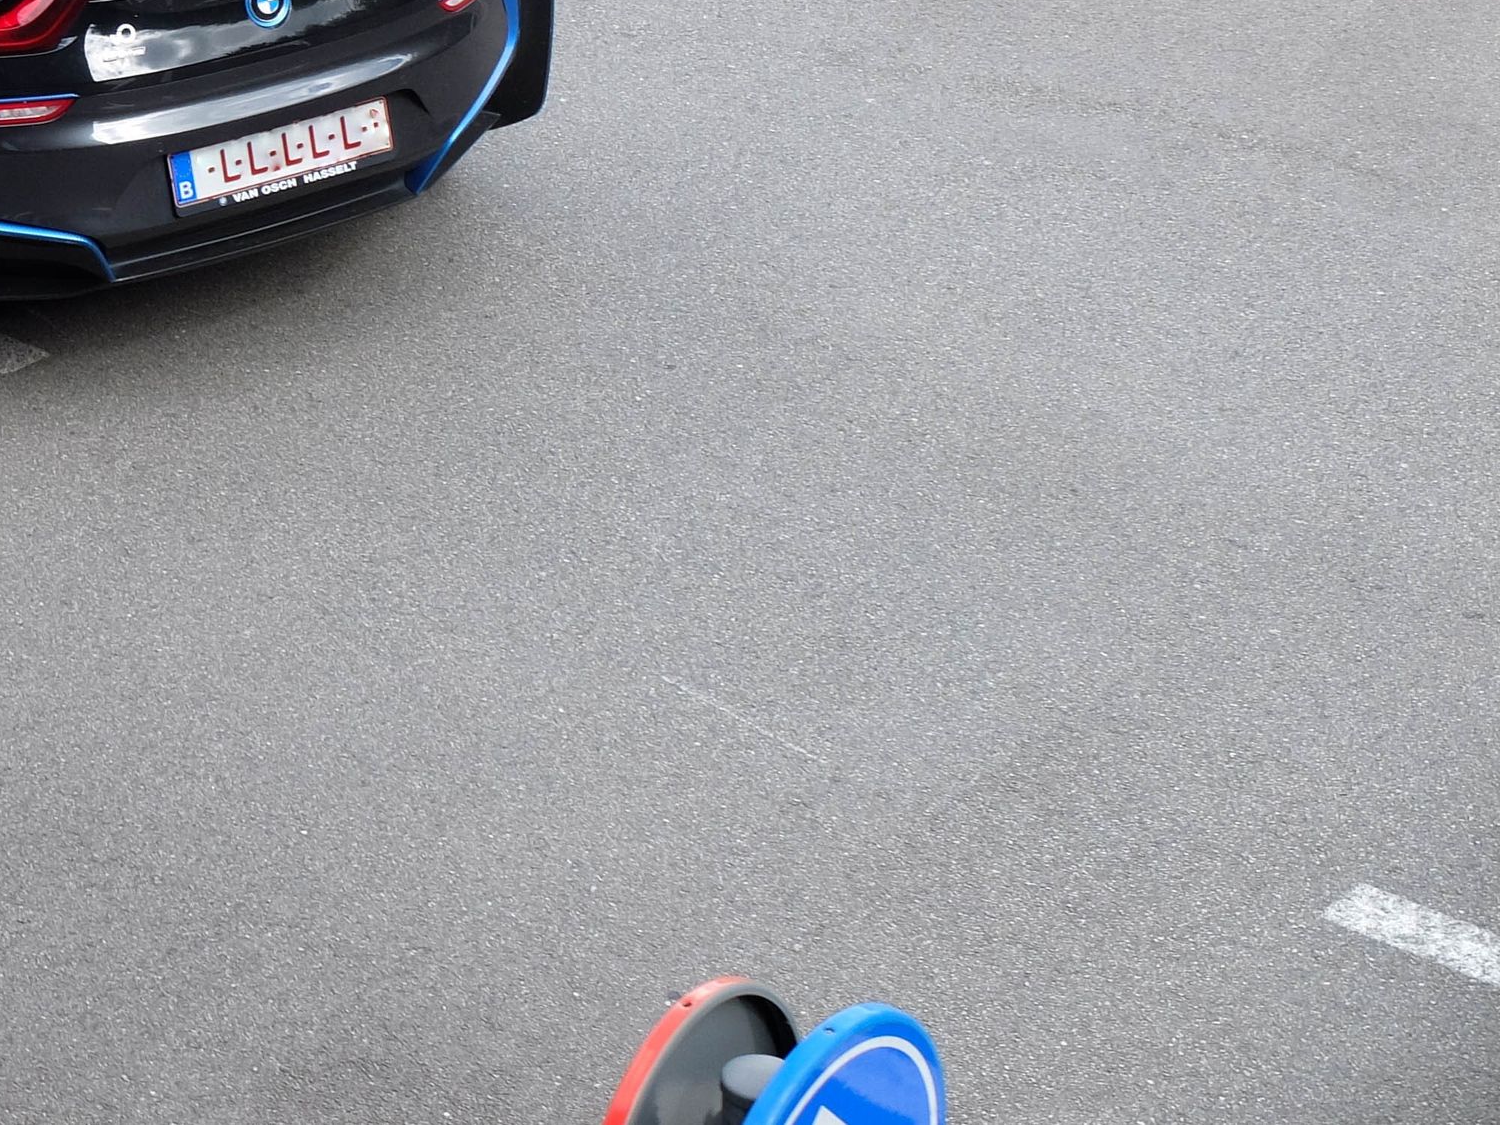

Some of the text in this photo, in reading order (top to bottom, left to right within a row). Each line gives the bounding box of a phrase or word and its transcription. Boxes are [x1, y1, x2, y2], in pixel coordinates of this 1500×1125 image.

[178, 180, 194, 200] B
[231, 161, 358, 203] VAN OSCH HASSELT
